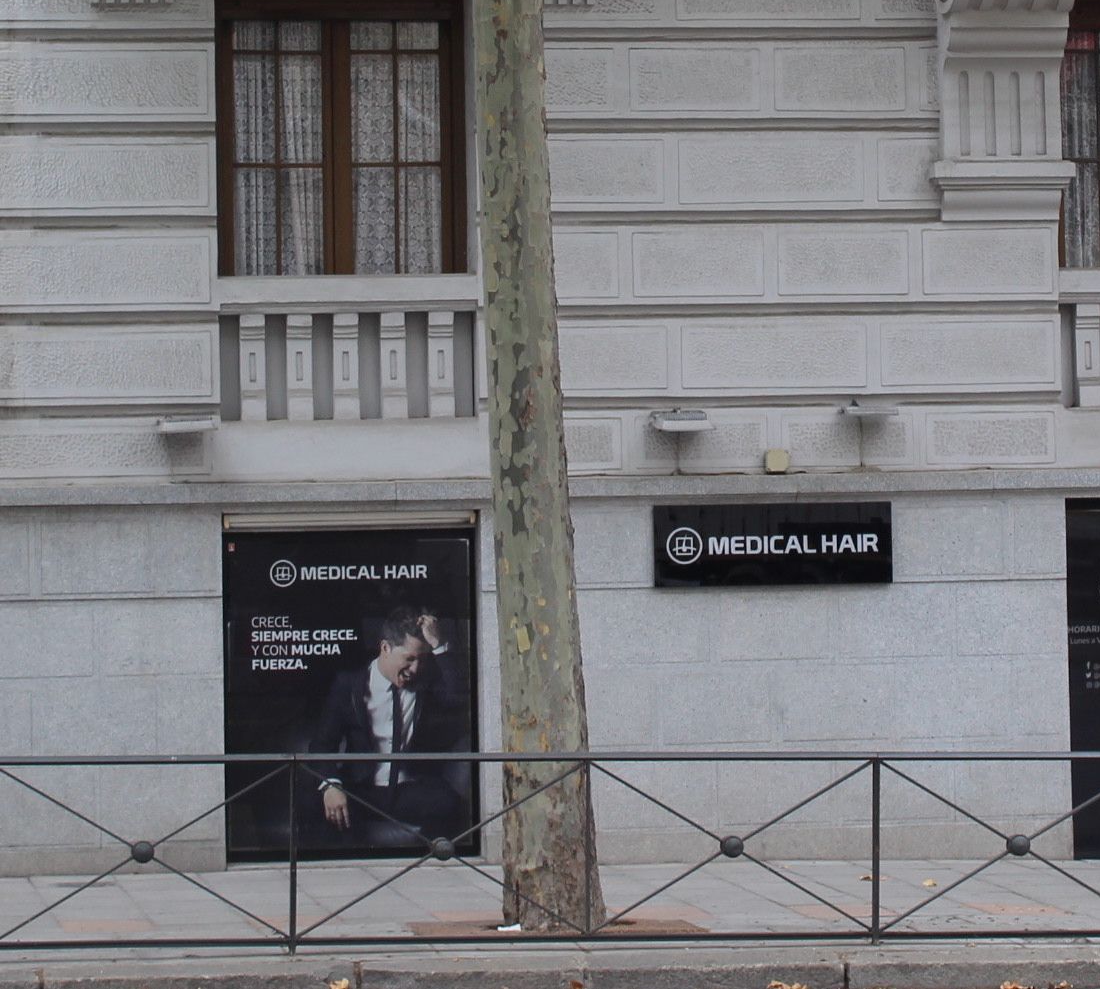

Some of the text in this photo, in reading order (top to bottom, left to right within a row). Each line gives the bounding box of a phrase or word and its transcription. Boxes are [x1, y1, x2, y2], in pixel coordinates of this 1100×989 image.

[707, 533, 879, 556] MEDICAL HAIR
[300, 564, 428, 581] MEDICAL HAIR
[250, 615, 293, 629] CRECE,
[250, 628, 358, 643] SIEMPRE CRECE.
[1070, 636, 1090, 645] Lunes
[251, 643, 342, 657] Y CON MUCHA
[251, 658, 308, 671] FUERZA.
